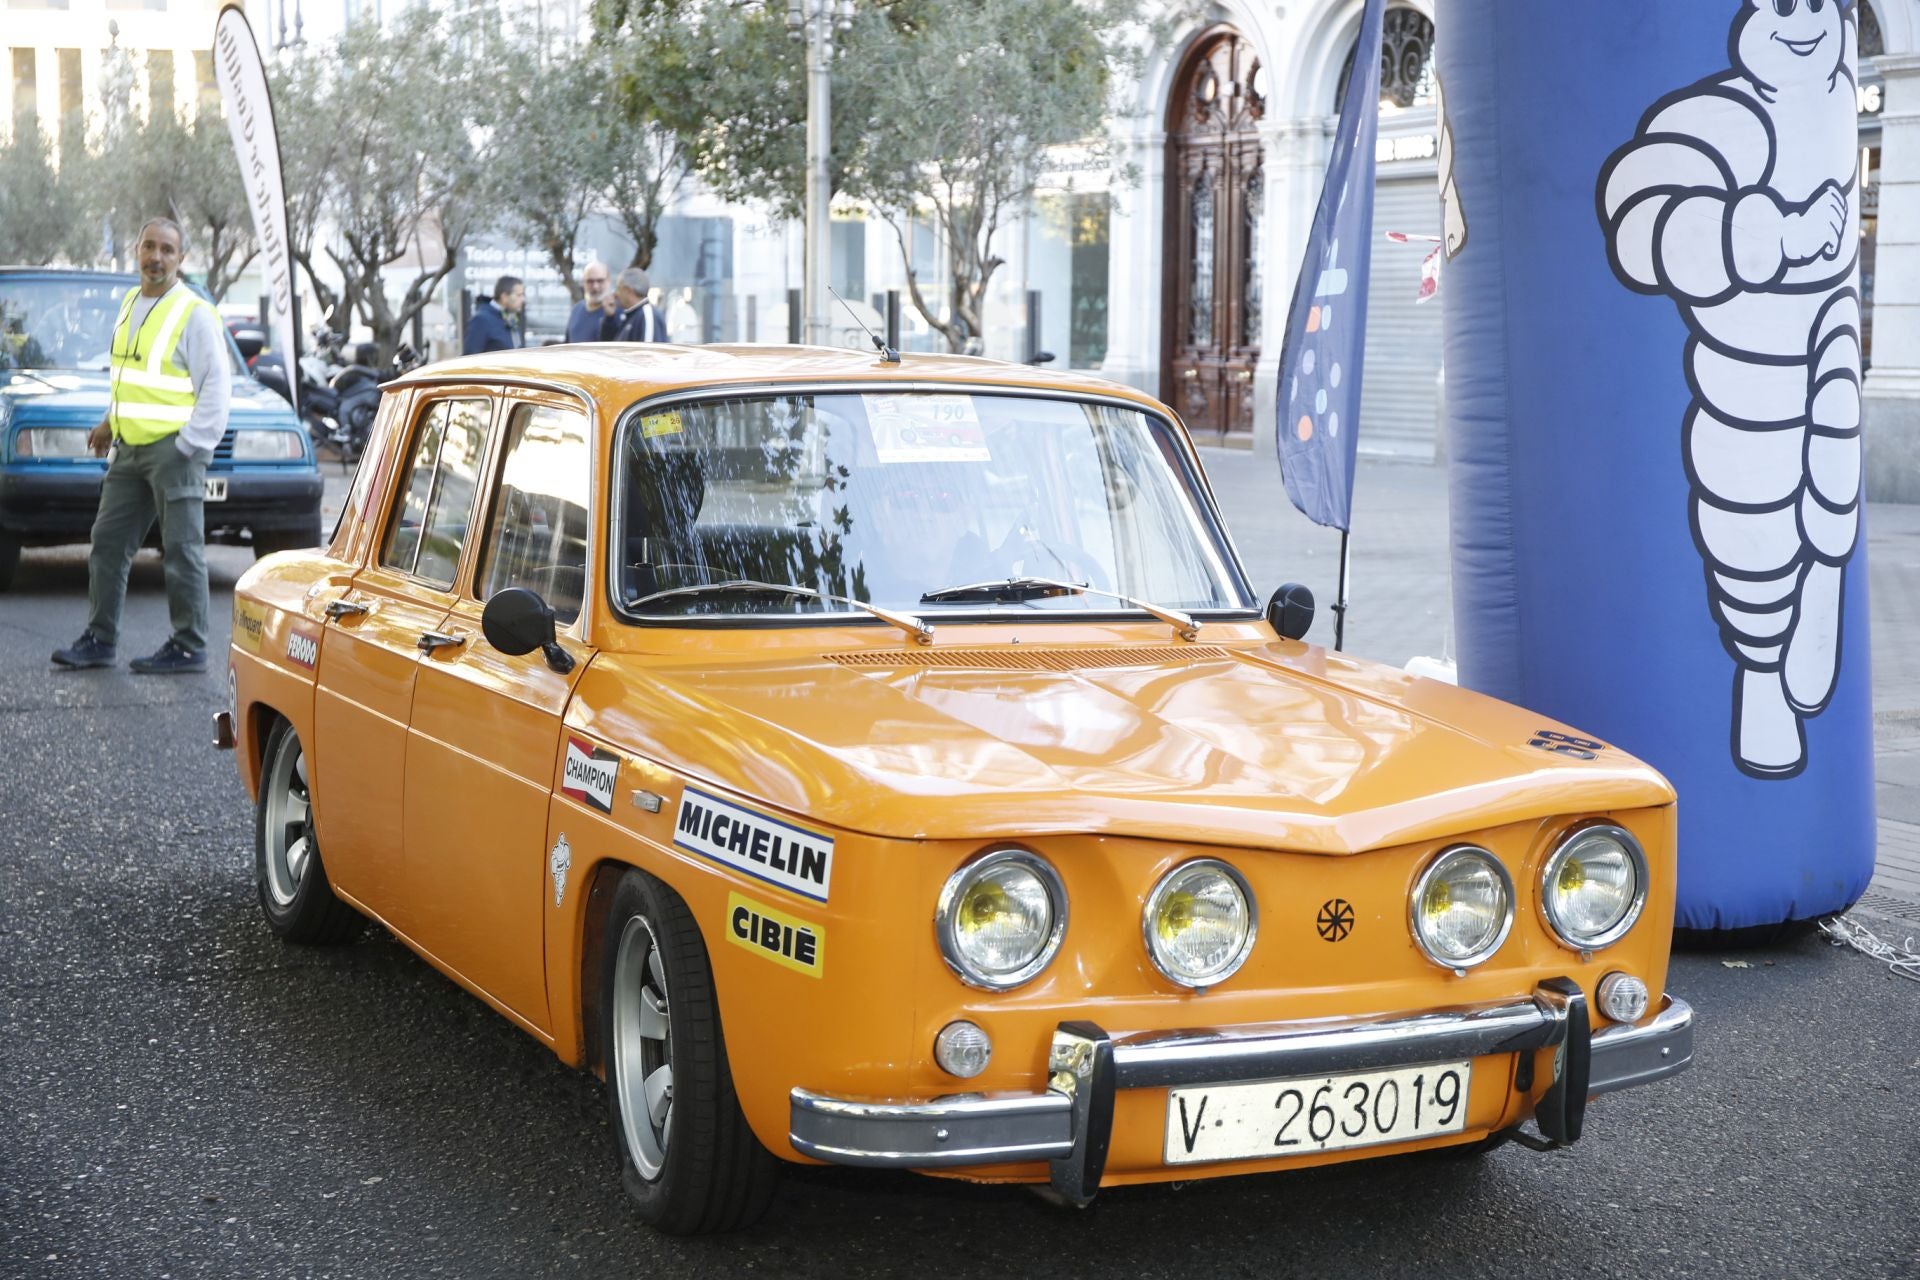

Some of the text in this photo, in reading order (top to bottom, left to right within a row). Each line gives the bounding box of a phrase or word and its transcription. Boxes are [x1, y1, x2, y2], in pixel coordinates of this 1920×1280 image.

[932, 404, 965, 421] 190
[287, 632, 318, 665] FERODO
[566, 756, 614, 795] CHAMPION
[678, 800, 827, 885] MICHELIN
[1273, 1069, 1461, 1146] 263019
